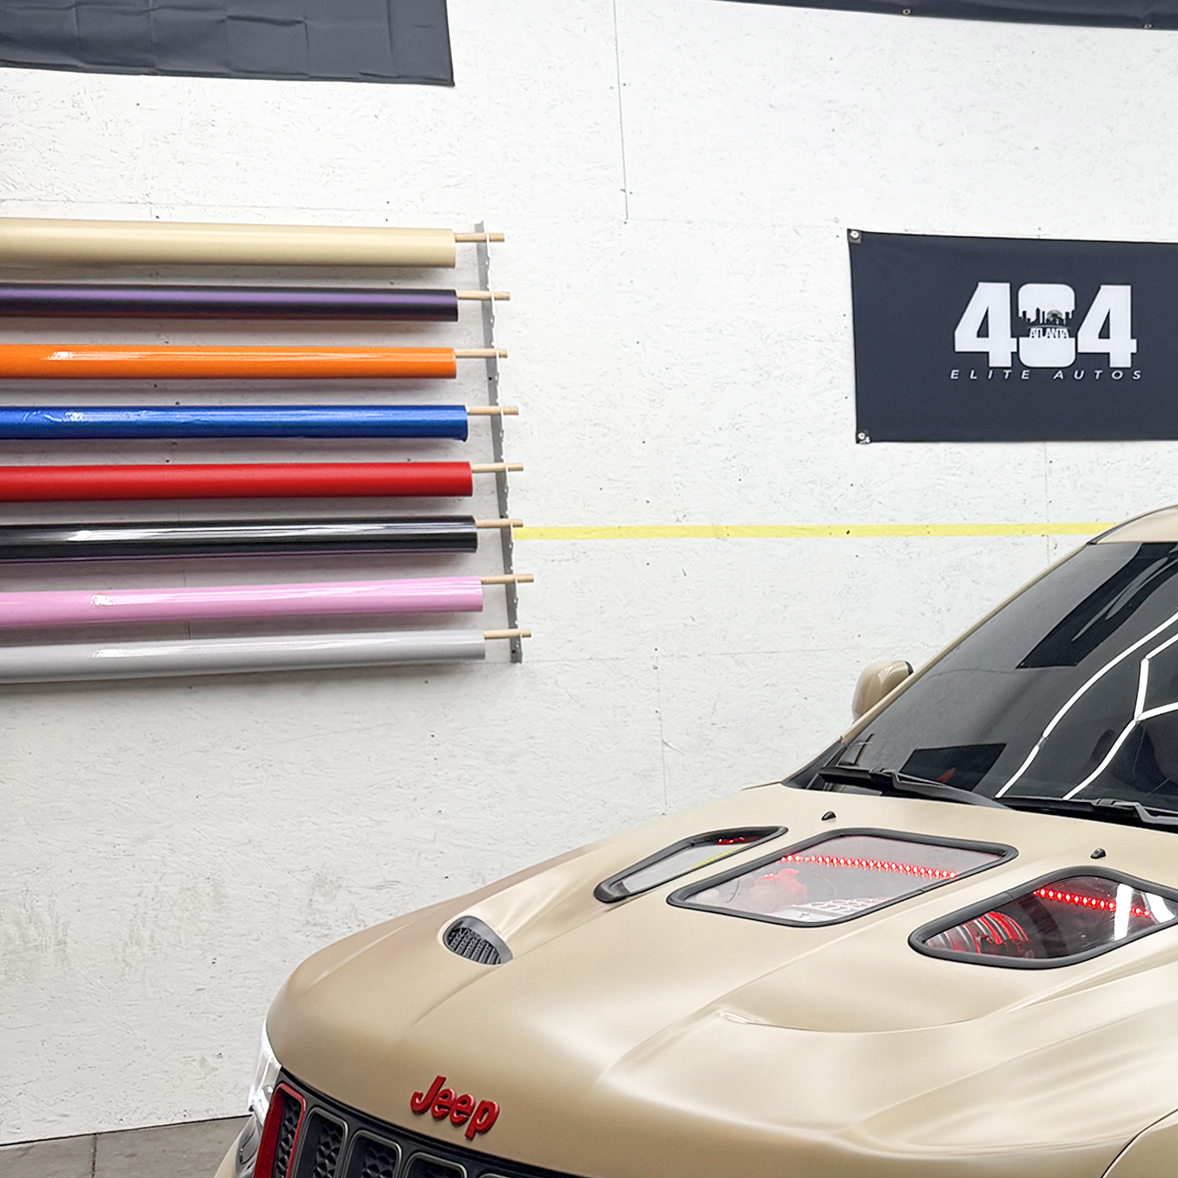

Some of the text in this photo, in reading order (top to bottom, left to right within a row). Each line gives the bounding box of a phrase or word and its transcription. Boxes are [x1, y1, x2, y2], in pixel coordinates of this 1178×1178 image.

[1029, 326, 1070, 339] ATLANTA
[950, 369, 1143, 381] ELITE AUTOS
[410, 1075, 500, 1141] Jeep
